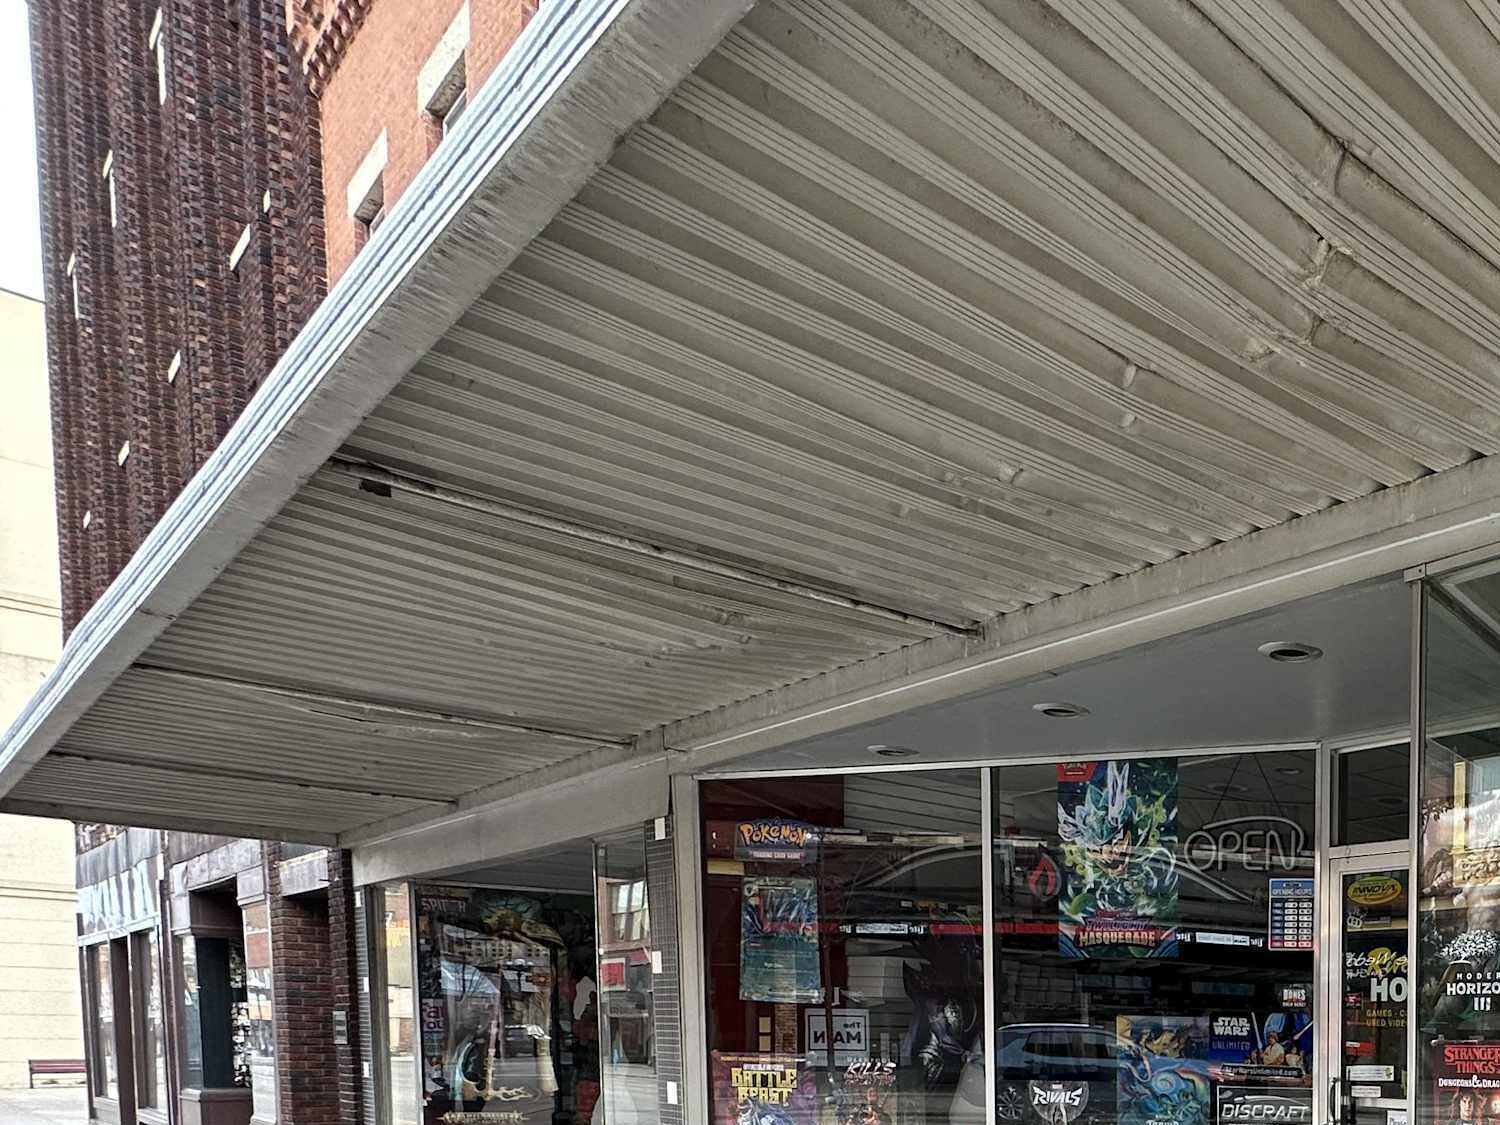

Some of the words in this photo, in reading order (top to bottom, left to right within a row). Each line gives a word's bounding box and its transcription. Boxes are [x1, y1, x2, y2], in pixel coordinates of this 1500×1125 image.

[1185, 830, 1298, 871] OPEN
[1353, 884, 1395, 895] INNOVA
[1080, 931, 1155, 946] MASQUERADE
[1473, 997, 1491, 1011] III
[1217, 1017, 1250, 1027] STAR
[1213, 1023, 1250, 1036] WARS
[1212, 1041, 1250, 1050] UNLIMITED
[846, 1062, 897, 1075] KILLS
[1455, 1061, 1497, 1074] THINGS
[731, 1067, 798, 1088] BATTLE
[1438, 1077, 1473, 1088] DUNGEONS
[737, 1087, 793, 1106] BEAST
[1032, 1086, 1083, 1106] RIVALS
[1222, 1104, 1309, 1119] DISCRAFT
